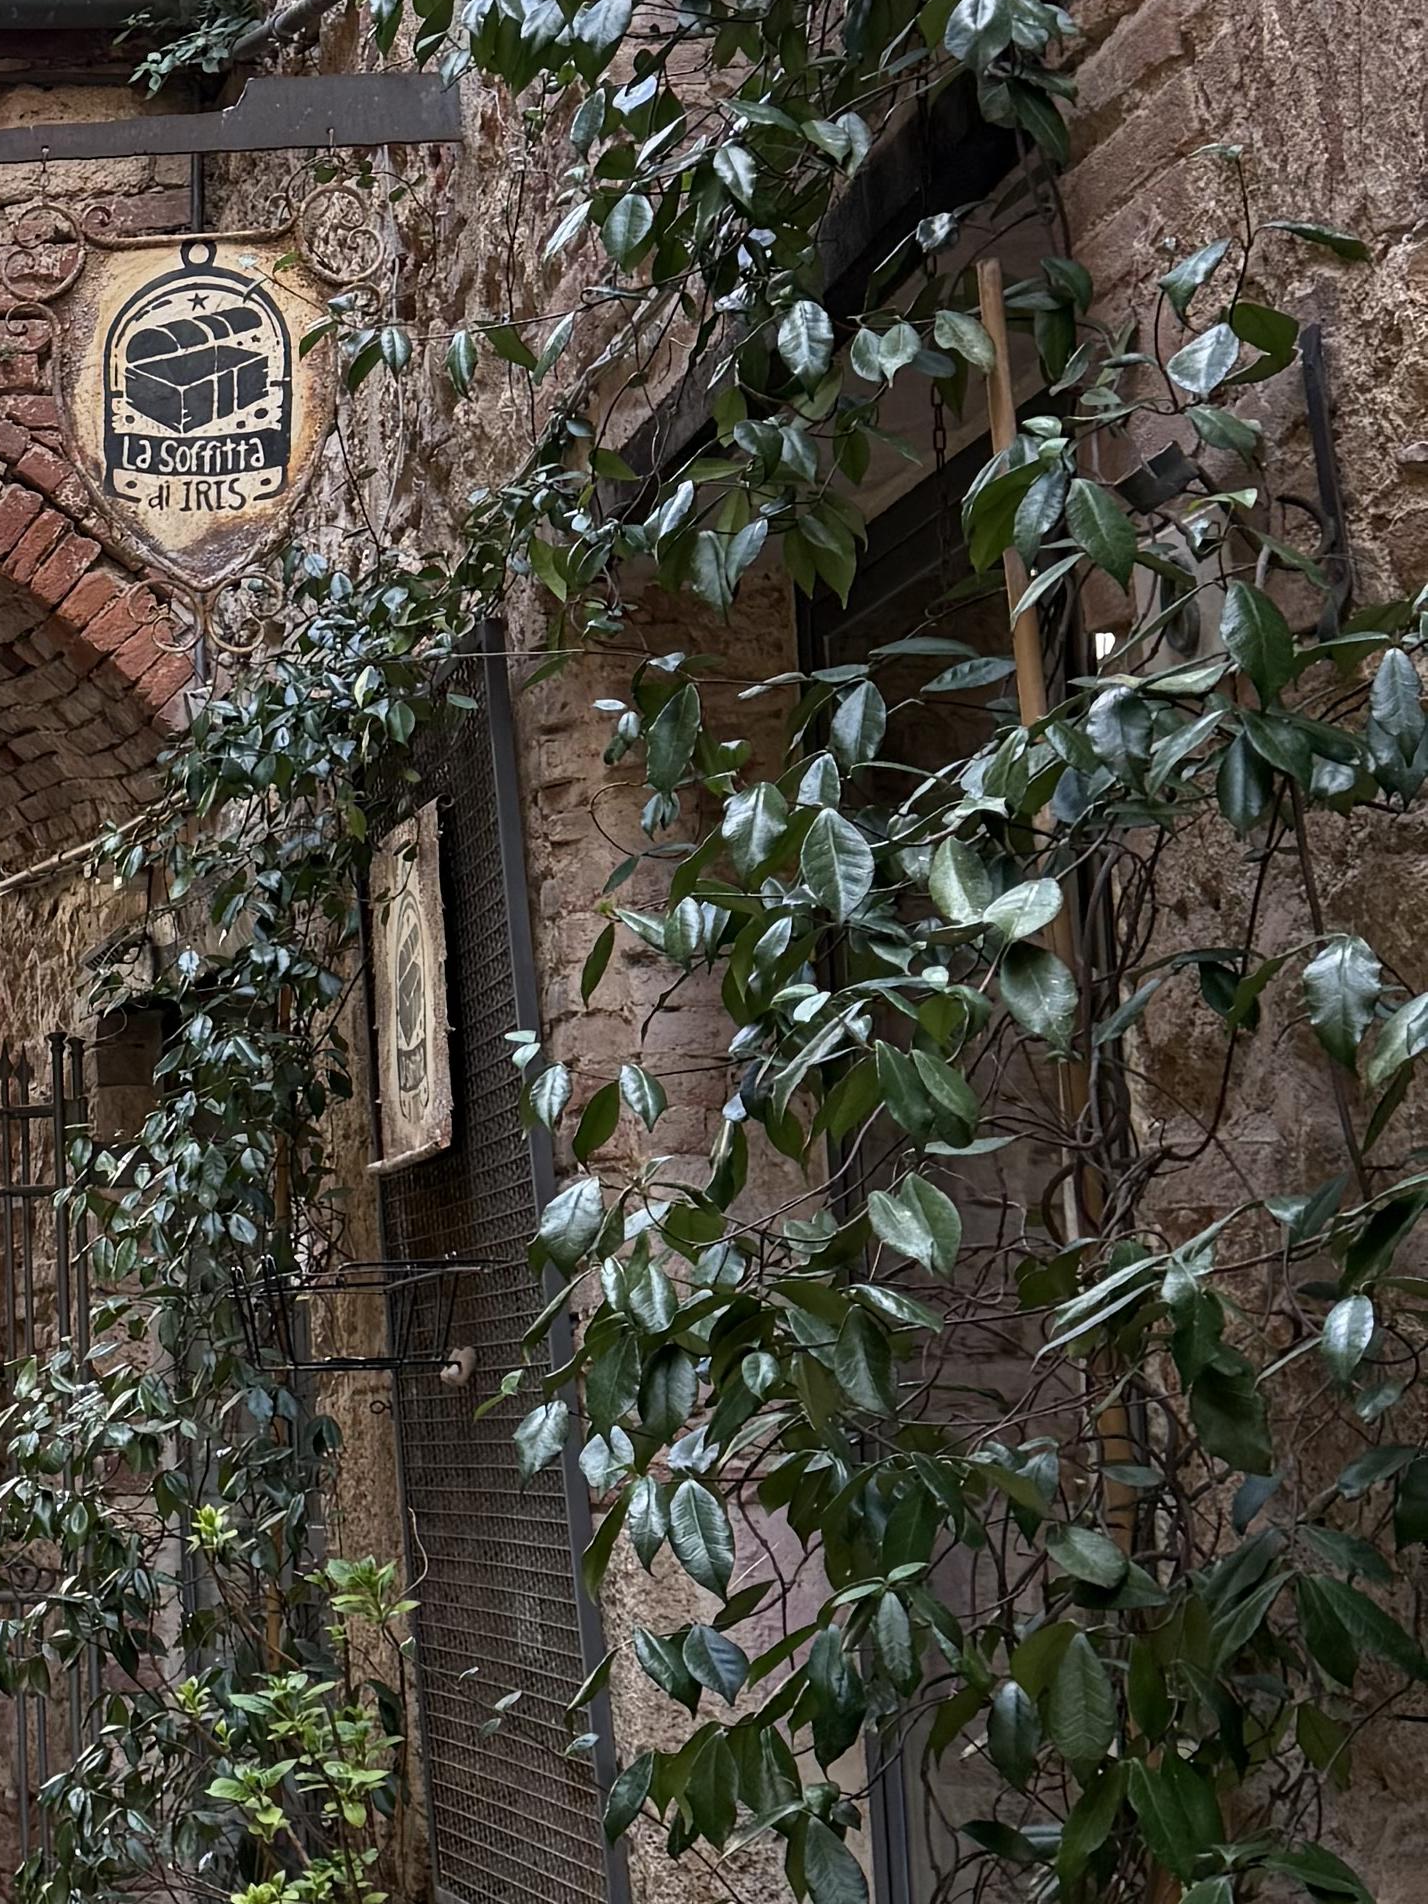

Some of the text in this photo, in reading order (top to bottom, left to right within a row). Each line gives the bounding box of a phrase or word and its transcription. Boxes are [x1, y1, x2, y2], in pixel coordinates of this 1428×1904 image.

[122, 435, 265, 473] La Soffitta
[148, 477, 247, 511] di IRIS
